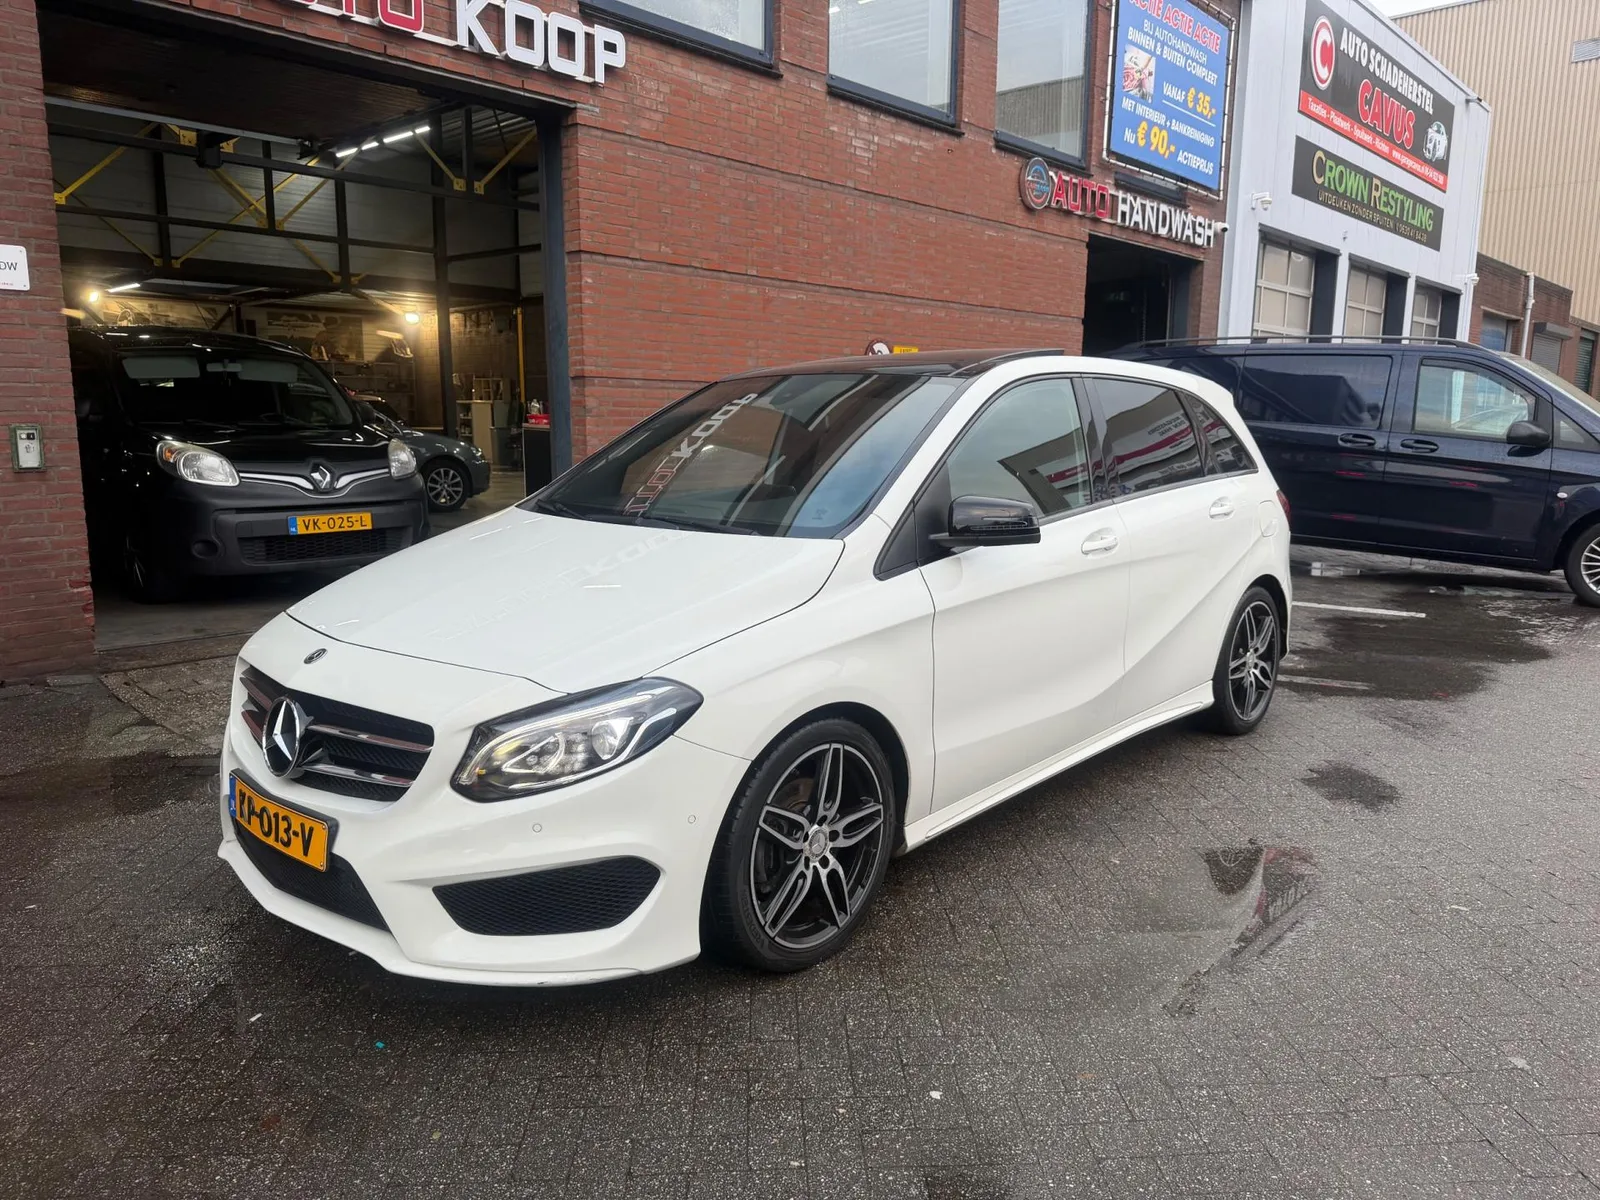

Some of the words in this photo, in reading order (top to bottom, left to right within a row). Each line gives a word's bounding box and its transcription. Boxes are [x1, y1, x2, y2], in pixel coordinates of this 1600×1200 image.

[457, 0, 625, 83] KOOP
[1127, 26, 1156, 52] BINNEN
[1155, 43, 1162, 56] &
[1162, 46, 1186, 69] BUITEN
[1186, 59, 1218, 87] COMPLEET
[1143, 19, 1154, 35] BIJ
[1154, 26, 1207, 66] AUTOHANDWASH
[1163, 4, 1194, 37] ACTIE
[1193, 23, 1221, 55] ACTIE
[1163, 81, 1186, 103] VANAF
[1340, 27, 1368, 67] AUTO
[1369, 48, 1434, 115] SCHADEHERSTEL
[1121, 96, 1135, 112] MET
[1135, 102, 1167, 126] INTERIEUR
[1170, 118, 1215, 148] BANKREINIGING
[1358, 79, 1416, 149] CAVUS
[1176, 149, 1214, 175] ACTIEPRIJS
[1051, 171, 1110, 219] AUTO
[1117, 189, 1215, 248] HANDWASH
[1312, 150, 1369, 204] CROWN
[1371, 177, 1434, 231] RESTYLING
[1318, 190, 1351, 212] UITDEUKEN
[1351, 203, 1373, 221] ZONDER
[302, 515, 367, 532] VK-025-L
[239, 788, 314, 857] KP-013-V
